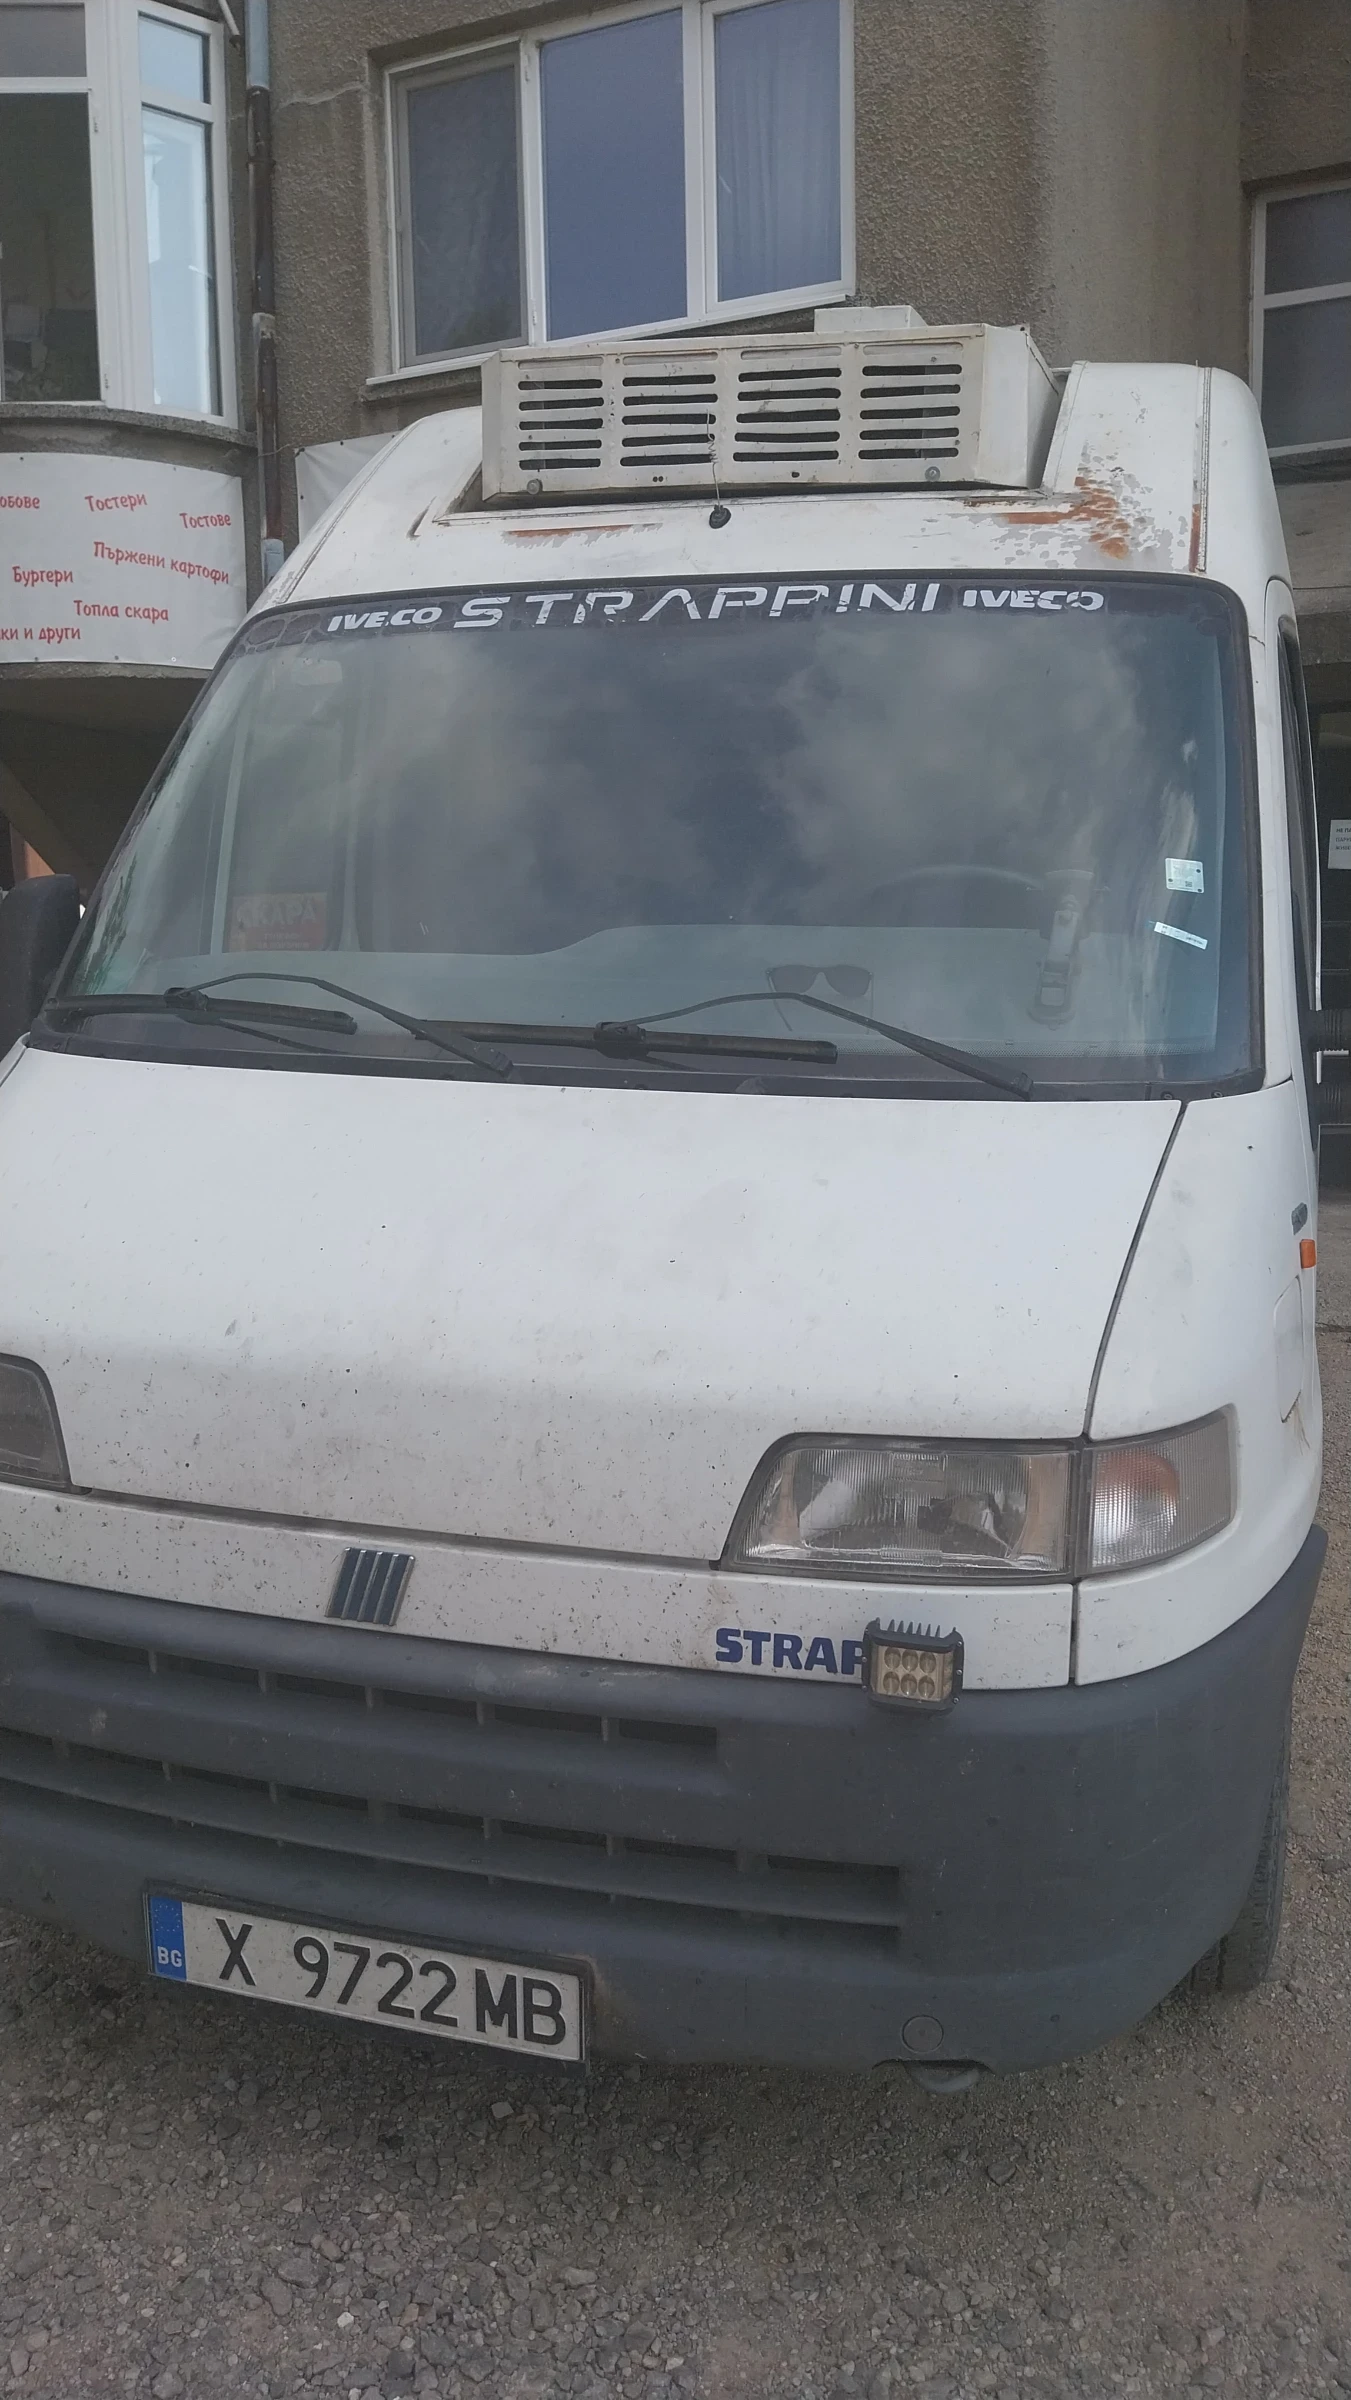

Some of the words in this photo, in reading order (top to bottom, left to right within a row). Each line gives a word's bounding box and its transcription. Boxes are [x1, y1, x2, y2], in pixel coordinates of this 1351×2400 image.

[85, 494, 147, 512] Тостери
[179, 512, 232, 529] Тостове
[93, 541, 165, 568] Пържени
[170, 558, 229, 585] картофи
[12, 565, 74, 587] Бургери
[73, 600, 119, 618] Топла
[125, 605, 169, 624] скара
[327, 606, 443, 632] IVECO
[453, 582, 941, 629] STRAPPINI
[962, 589, 1105, 611] IVECO
[0, 628, 19, 641] ки
[24, 628, 33, 640] и
[38, 626, 81, 644] други
[715, 1627, 863, 1675] STRAP
[157, 1945, 183, 1968] BG
[215, 1917, 256, 1986] X
[293, 1935, 458, 2028] 9722
[474, 1967, 567, 2046] MB
